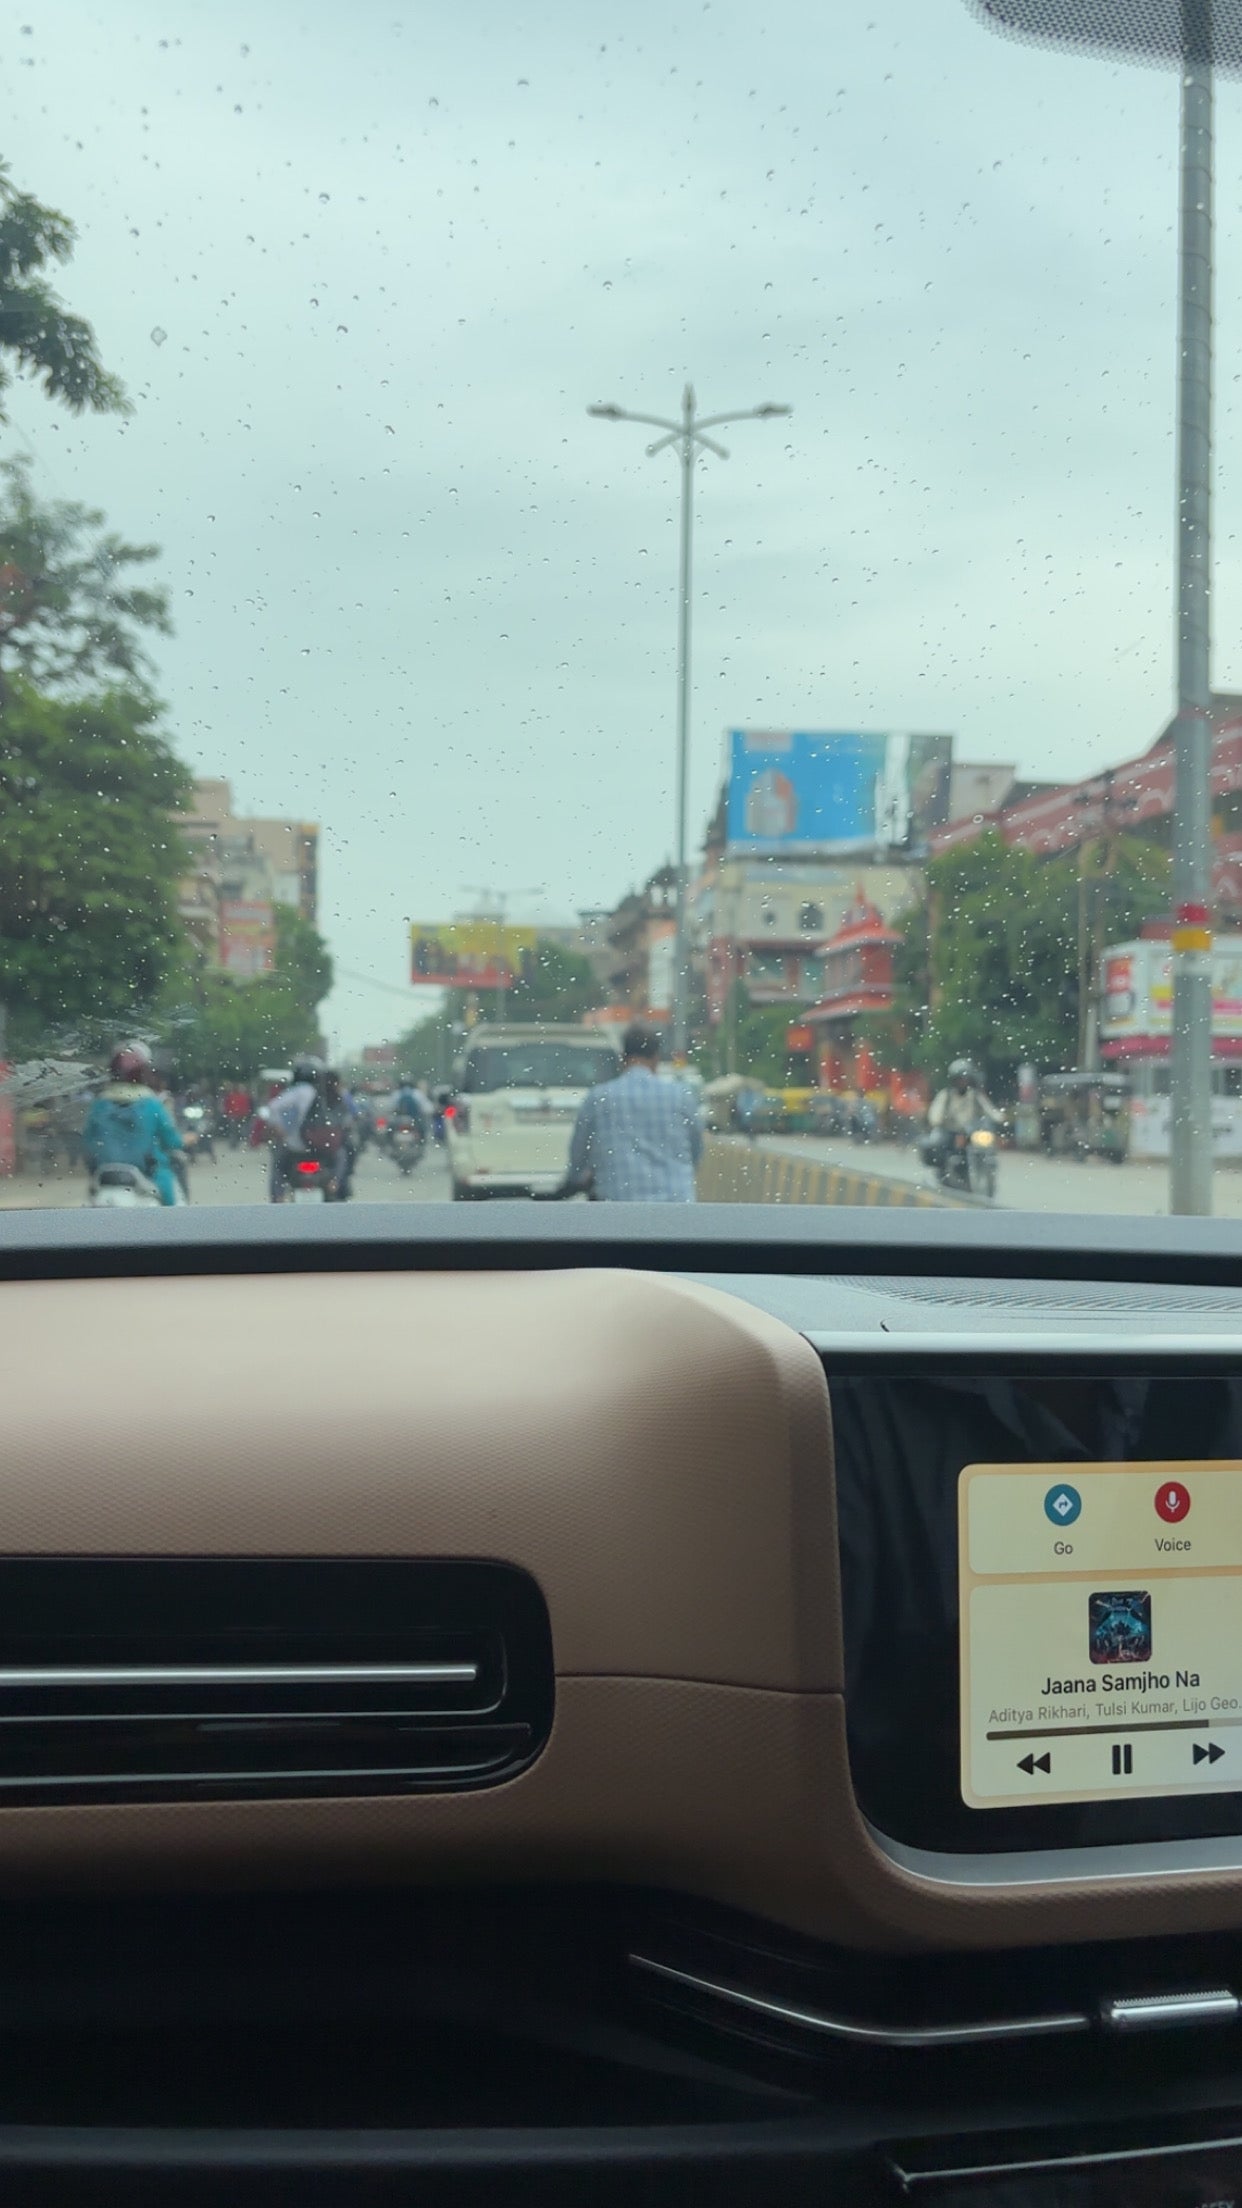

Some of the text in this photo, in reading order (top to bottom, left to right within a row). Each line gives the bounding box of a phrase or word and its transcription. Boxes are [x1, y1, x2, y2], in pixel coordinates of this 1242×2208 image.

[1053, 1541, 1074, 1555] Go
[1155, 1537, 1192, 1552] Voice
[1041, 1670, 1200, 1695] Jaana Samjho Na
[988, 1706, 1034, 1725] Aditya
[1038, 1703, 1090, 1720] Rikhari,
[1095, 1701, 1127, 1717] Tulsi
[1131, 1701, 1179, 1715] Kumar,
[1182, 1697, 1207, 1714] Lijo
